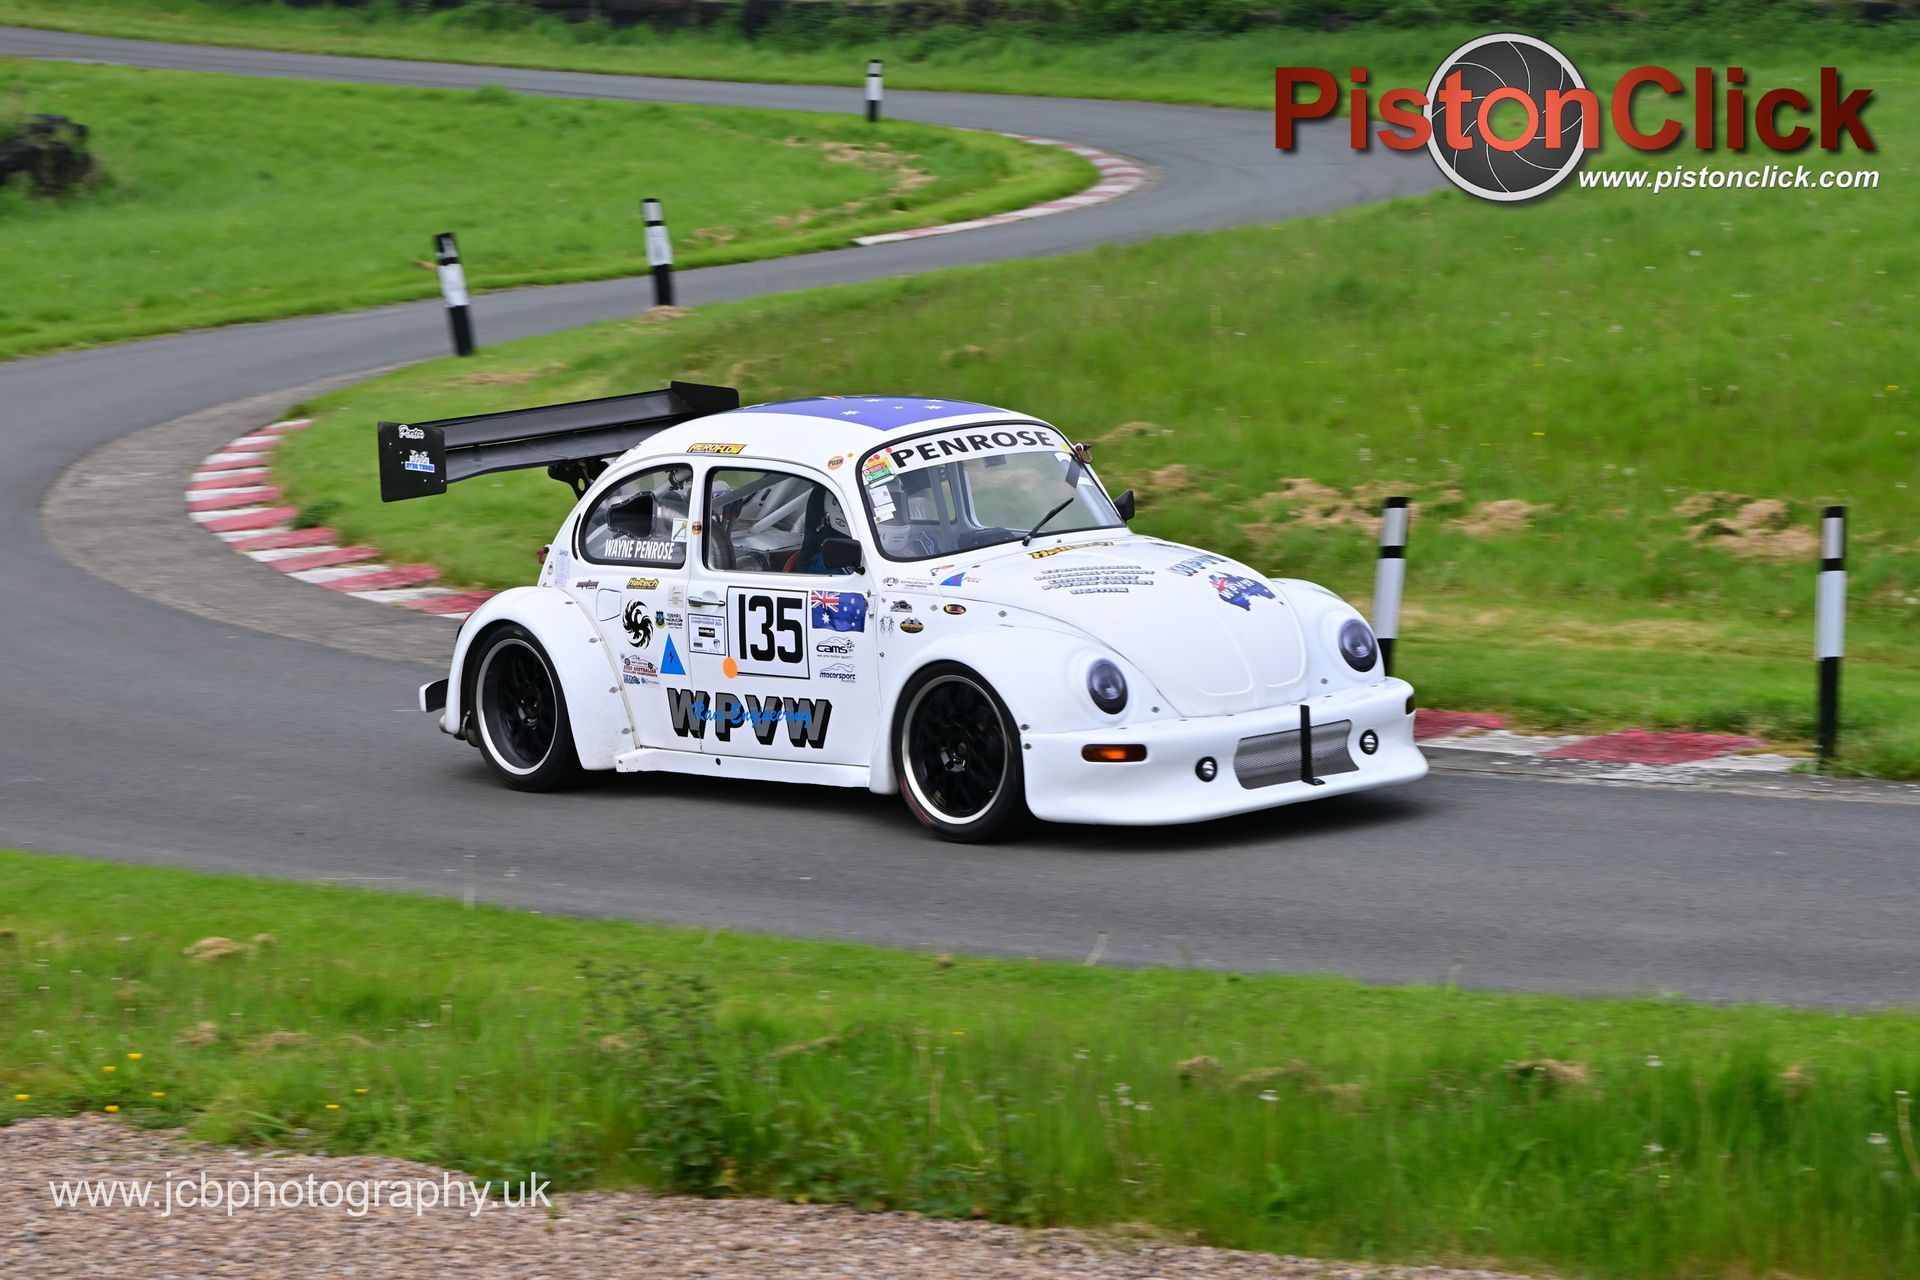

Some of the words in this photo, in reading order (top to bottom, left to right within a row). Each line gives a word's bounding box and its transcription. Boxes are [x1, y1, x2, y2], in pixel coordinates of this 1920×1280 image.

[890, 430, 1055, 468] PENROSE
[604, 539, 634, 558] WAYNE
[633, 540, 675, 560] PENROSE
[738, 593, 802, 664] 135
[816, 644, 848, 654] cams
[667, 688, 833, 750] WPVW
[691, 701, 729, 721] Race
[730, 702, 811, 729] Engineering
